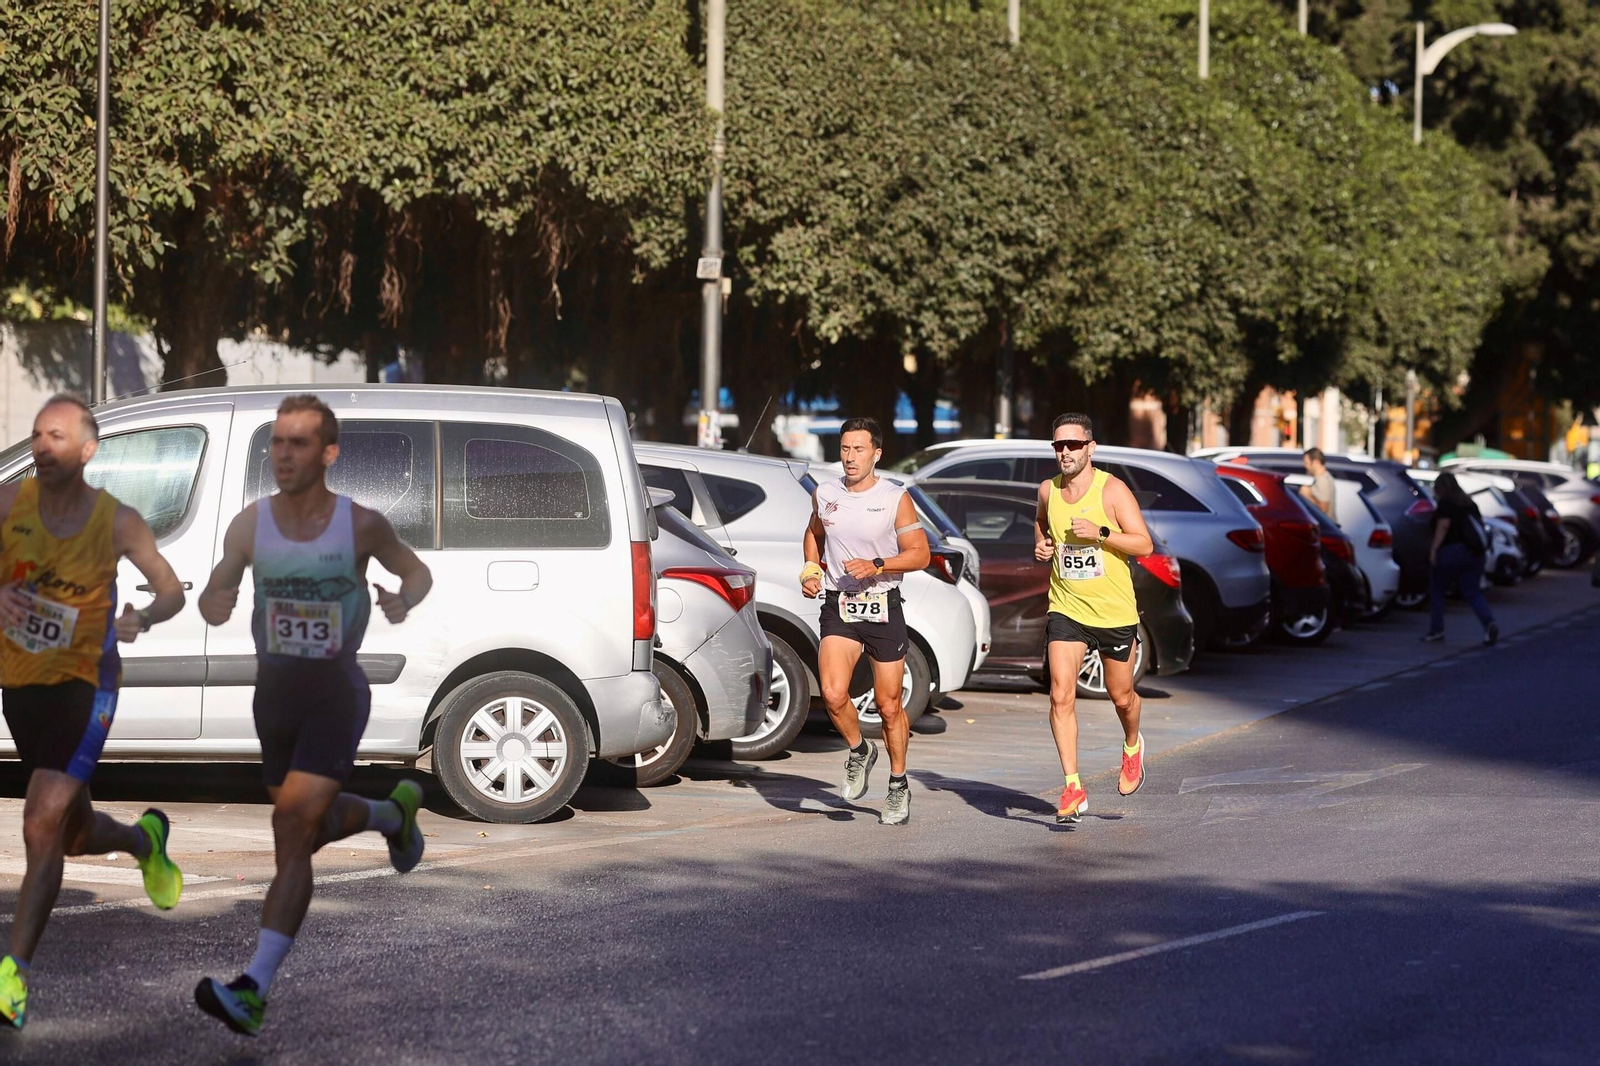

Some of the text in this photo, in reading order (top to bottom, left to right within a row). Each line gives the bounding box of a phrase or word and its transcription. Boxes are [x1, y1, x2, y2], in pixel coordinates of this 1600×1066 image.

[1063, 555, 1097, 569] 654
[846, 602, 881, 615] 378
[26, 614, 61, 642] 50
[278, 618, 330, 641] 313
